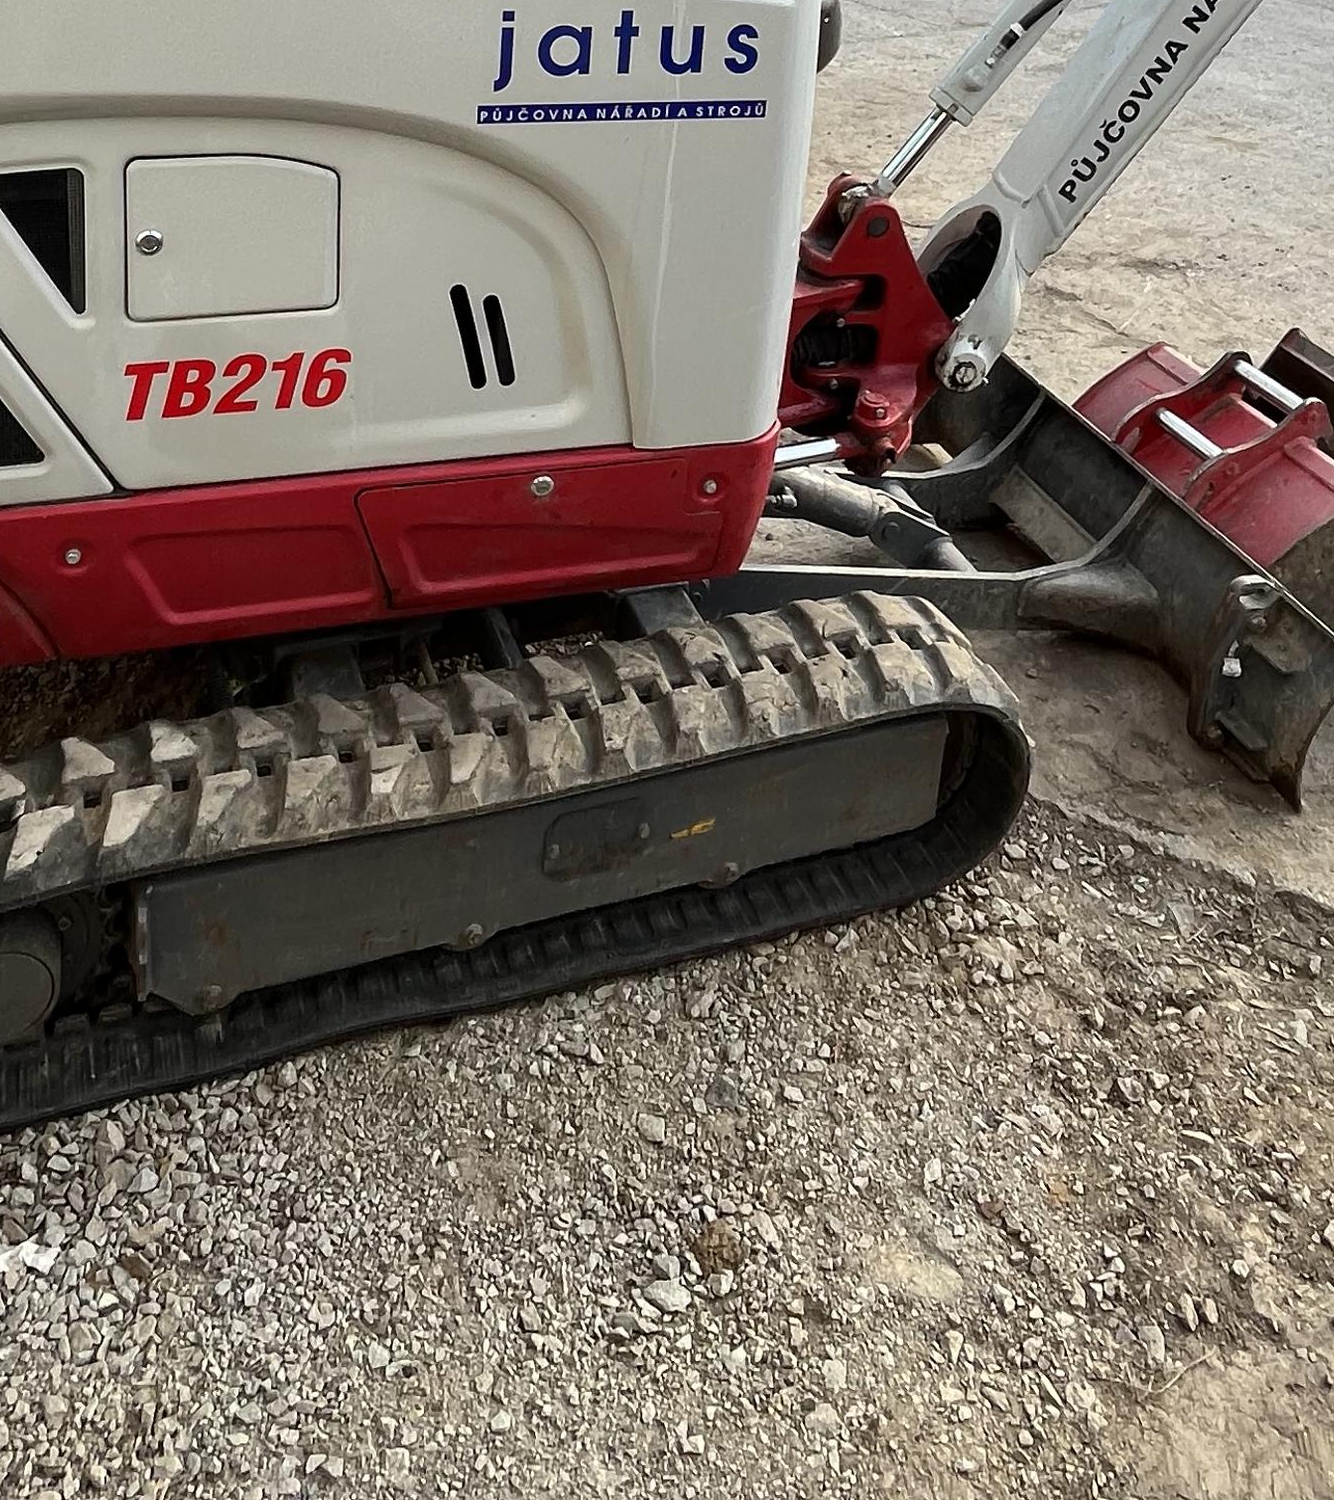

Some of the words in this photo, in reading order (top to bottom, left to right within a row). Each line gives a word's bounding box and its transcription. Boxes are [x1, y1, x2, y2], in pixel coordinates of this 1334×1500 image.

[493, 10, 759, 92] jatus
[480, 107, 587, 122] PŮJČOVNA
[596, 104, 671, 120] NÁŘADÍ
[677, 107, 687, 117] A
[696, 103, 764, 117] STROJŮ
[1058, 39, 1189, 204] PŮJČOVNA
[124, 348, 352, 421] TB216
